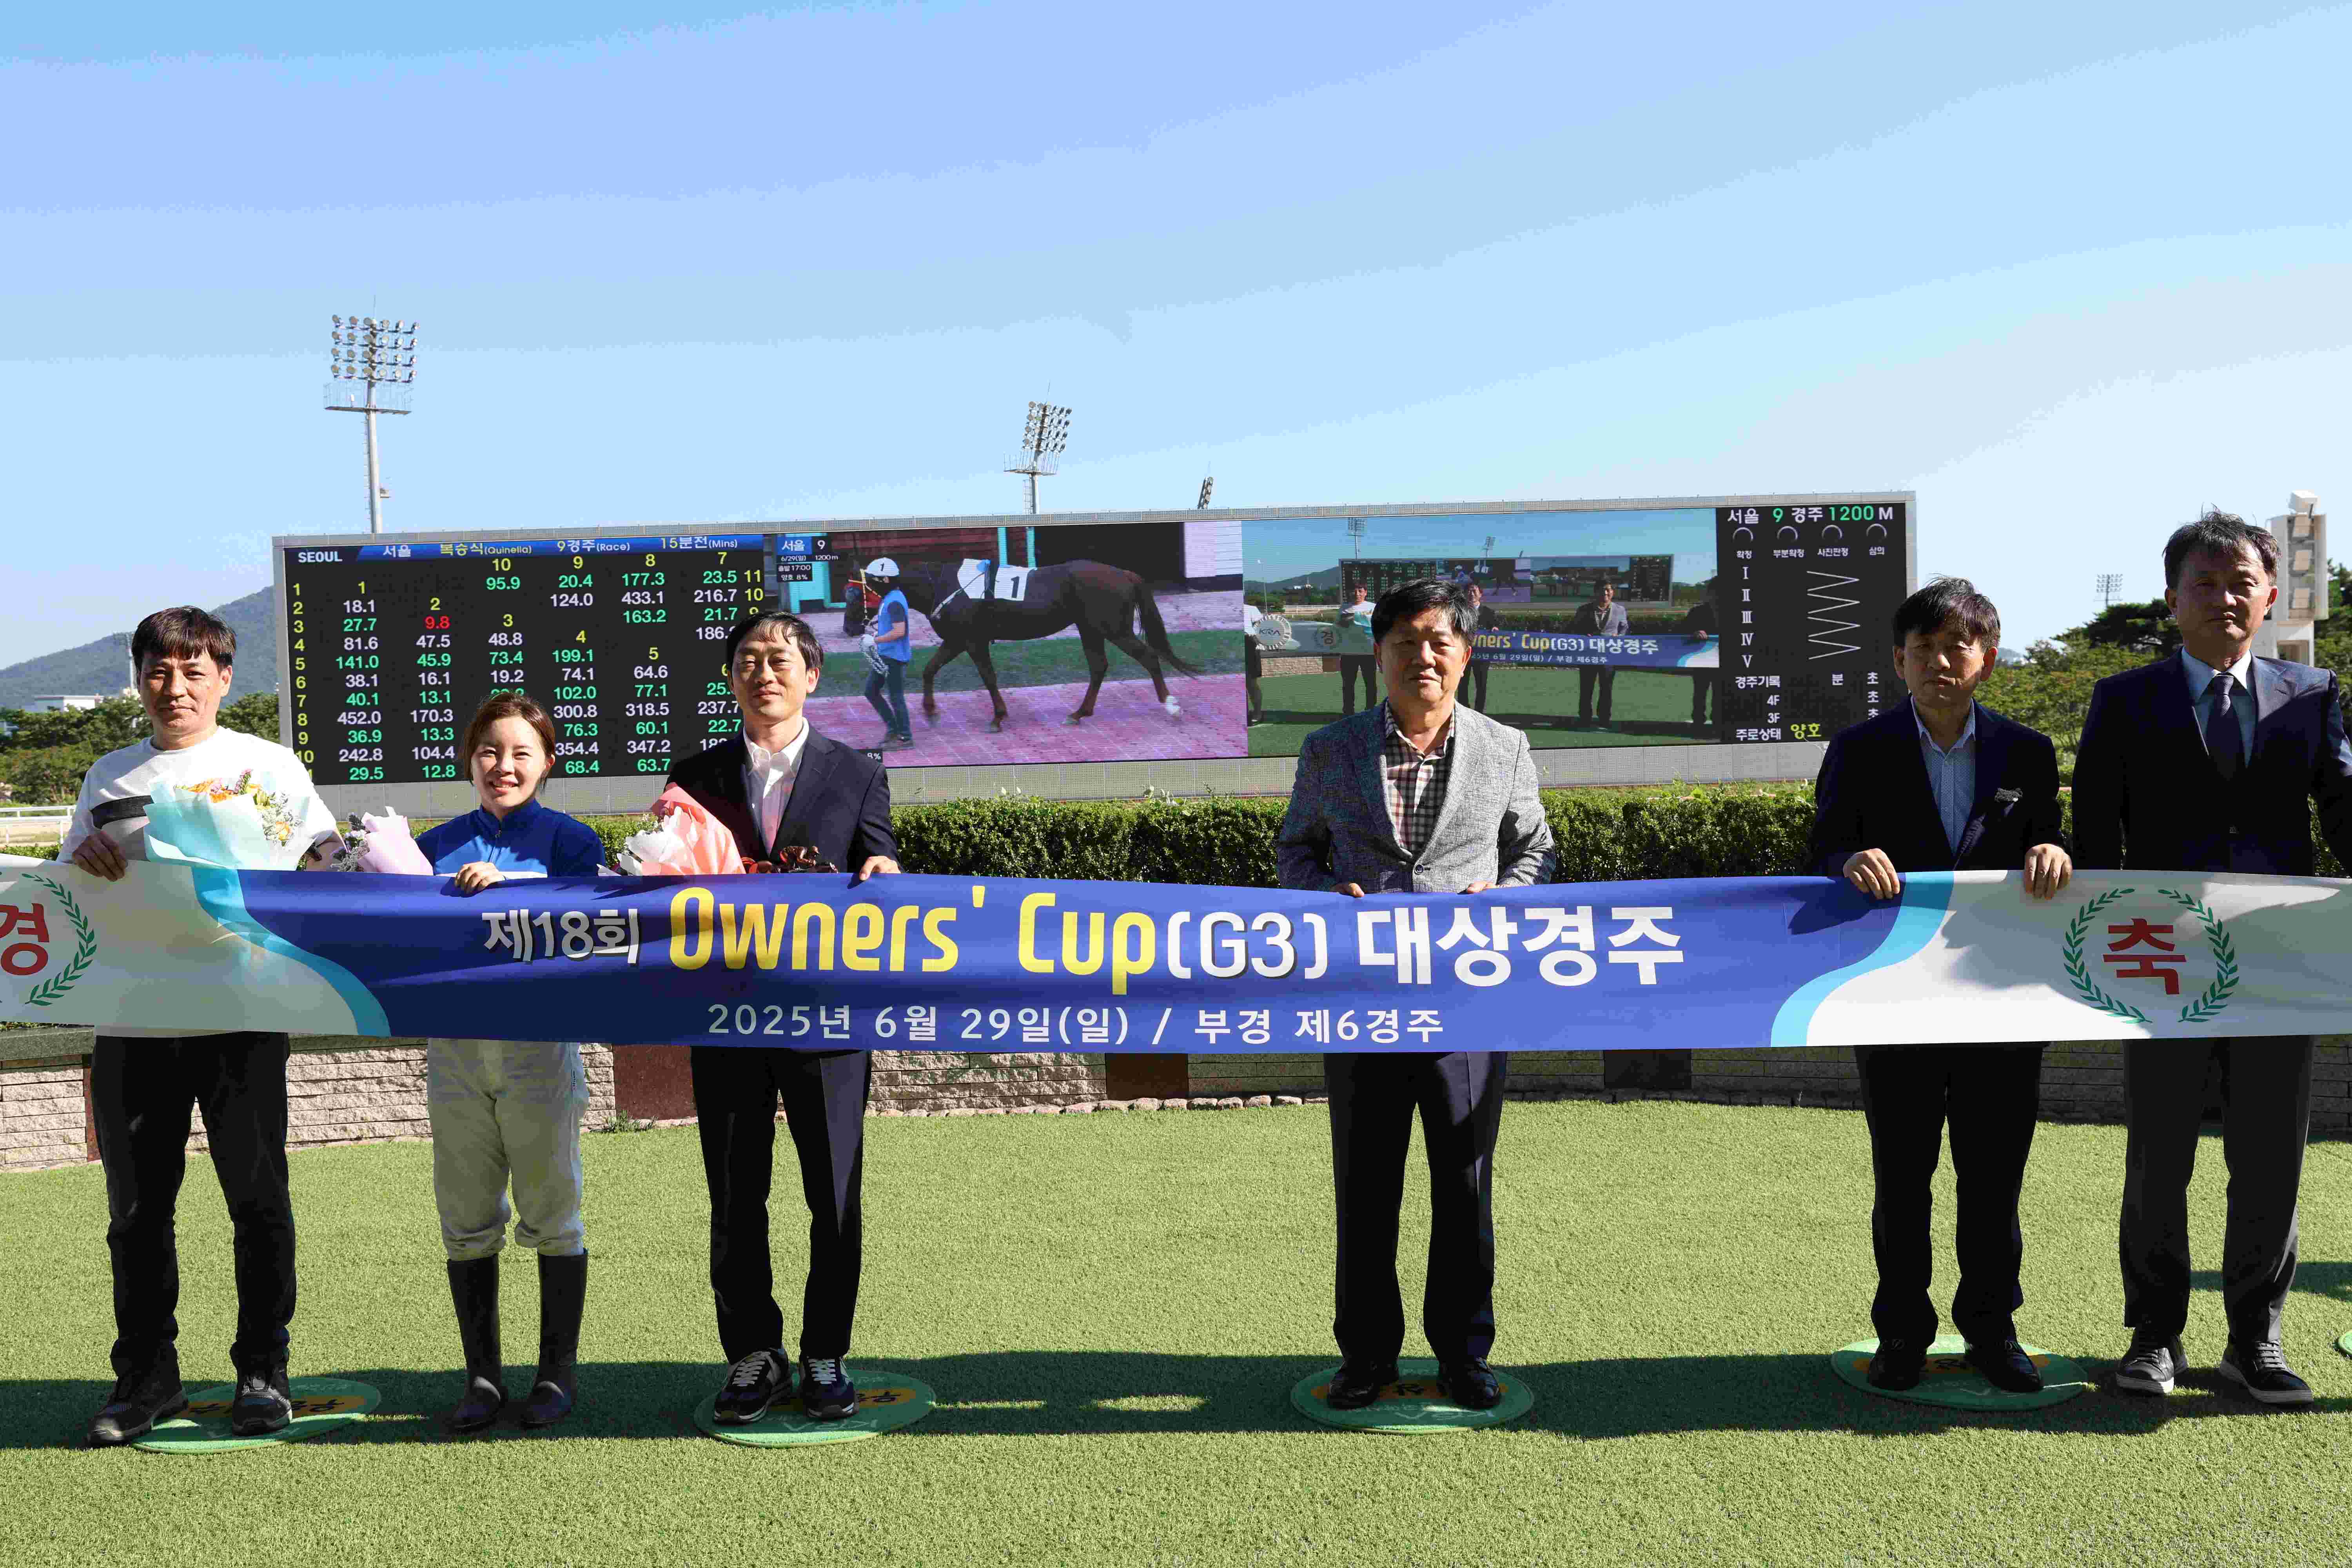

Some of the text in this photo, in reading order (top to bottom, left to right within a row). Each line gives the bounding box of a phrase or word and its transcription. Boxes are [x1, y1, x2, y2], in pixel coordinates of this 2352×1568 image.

[1728, 506, 1893, 524] 서울 9 경주 1200 M
[298, 551, 342, 563] SEOUL
[383, 544, 411, 557] 서울
[782, 540, 825, 552] 서울 9
[492, 552, 727, 571] 10 9 8 7
[880, 562, 885, 572] 1
[293, 570, 760, 596] 1 1 95.9 20.4 177.3 23.5 11
[1011, 576, 1022, 599] 1
[293, 588, 764, 615] 2 18.1 2 124.0 433.1 216.7 10
[294, 620, 304, 633] 3
[343, 618, 377, 632] 27.7
[425, 615, 450, 630] 9.8
[503, 614, 513, 627] 3
[623, 609, 666, 623] 163.2
[704, 607, 738, 621] 21.7
[294, 639, 305, 652] 4
[344, 636, 378, 651] 81.6
[416, 634, 450, 648] 47.5
[488, 632, 523, 646] 48.8
[576, 630, 586, 643] 4
[1521, 633, 1584, 652] Cup(G3)
[1589, 638, 1658, 655] 대상경주
[295, 647, 659, 670] 5 141.0 45.9 73.4 199.1 5
[296, 676, 306, 689] 6
[345, 674, 377, 688] 38.1
[418, 671, 450, 685] 16.1
[490, 670, 524, 683] 19.2
[562, 668, 593, 681] 74.1
[633, 665, 668, 679] 64.6
[1735, 671, 1879, 689] 경주기록 분 초
[297, 682, 735, 707] 7 40.1 13.1 102.0 77.1 25.
[1767, 690, 1879, 706] 4F 초
[298, 701, 739, 726] 8 452.0 170.3 300.8 318.5 237.7
[1768, 713, 1780, 724] 3F
[298, 719, 742, 744] 9 36.9 13.3 76.3 60.1 22.7
[1736, 723, 1822, 741] 주로상태 양호
[295, 750, 314, 763] 10
[339, 748, 383, 762] 242.8
[412, 746, 455, 760] 104.4
[555, 742, 599, 756] 354.4
[627, 739, 671, 754] 347.2
[349, 767, 384, 780] 29.5
[422, 764, 456, 778] 12.8
[565, 760, 600, 774] 68.4
[637, 758, 671, 772] 63.7
[0, 903, 49, 976] 경
[481, 886, 1684, 995] 제18회 Owners' Cup(G3) 대상경주
[2103, 918, 2186, 995] 축
[708, 1003, 1445, 1045] 2025년 6월 29일(일) / 부경 제6경주
